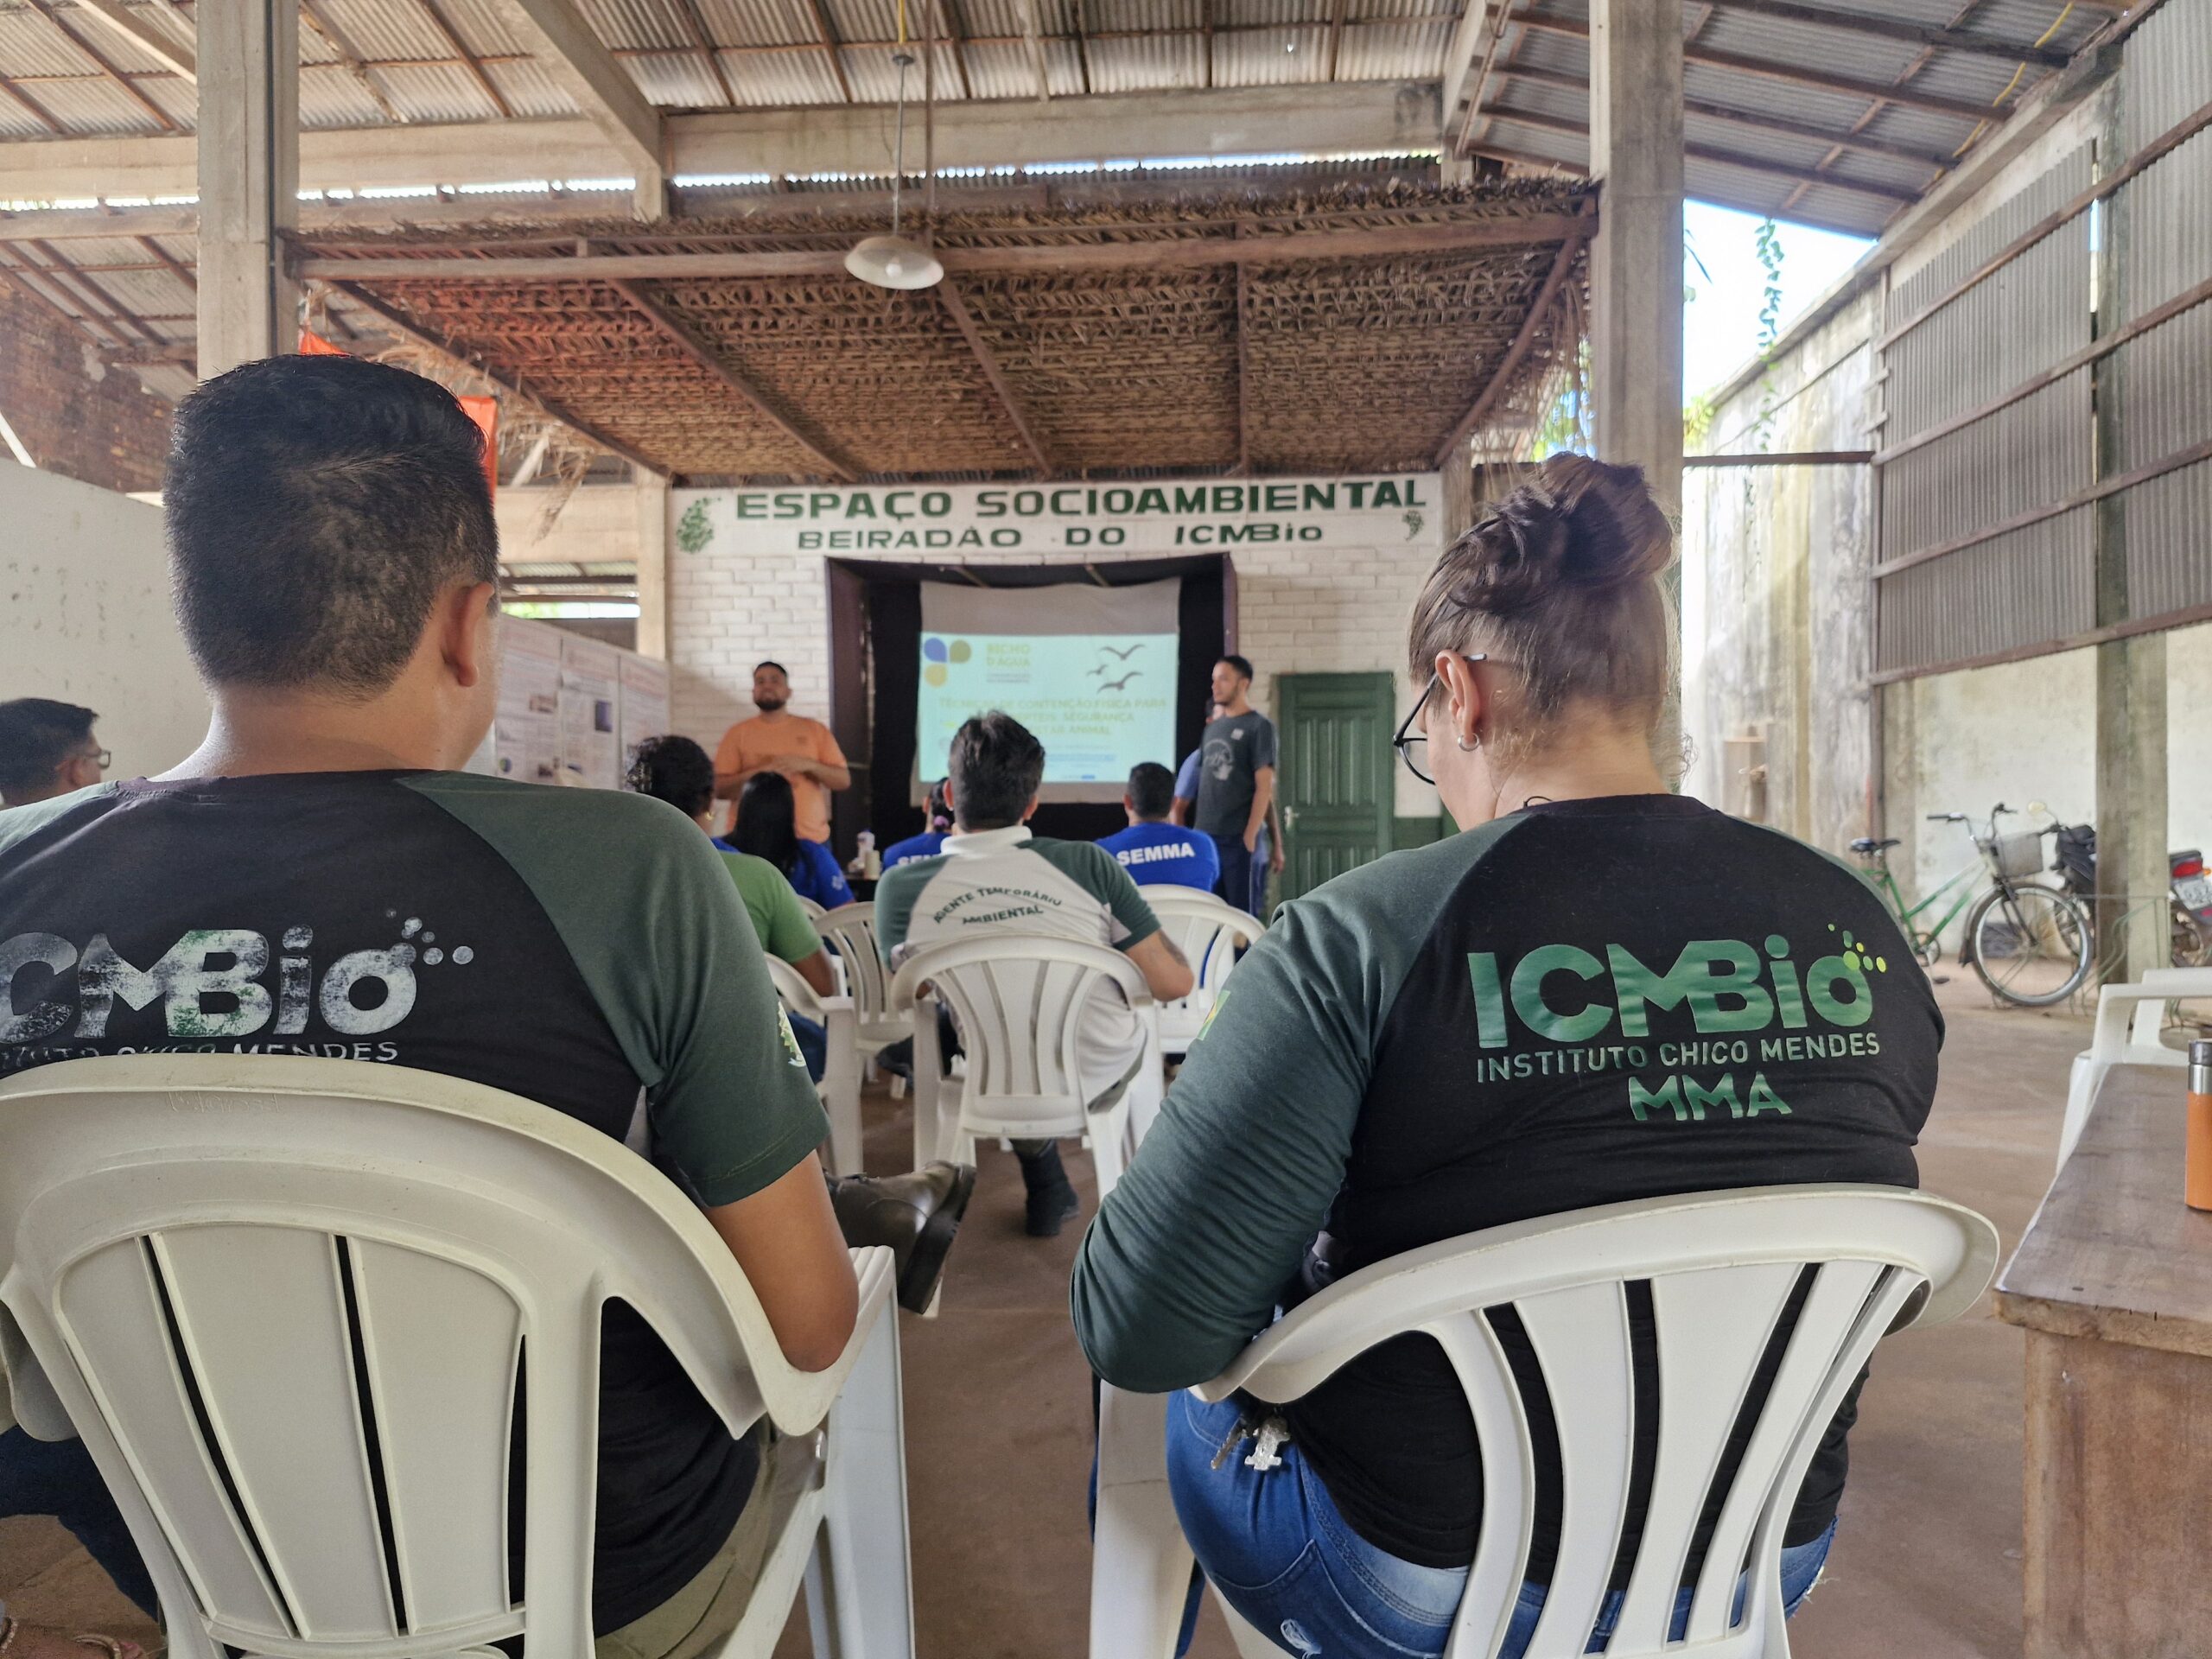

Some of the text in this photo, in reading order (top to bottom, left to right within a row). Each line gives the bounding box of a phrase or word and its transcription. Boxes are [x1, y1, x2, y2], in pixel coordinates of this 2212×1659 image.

[736, 480, 1427, 522] ESPAÇO SOCIOAMBIENTAL
[1065, 527, 1125, 546] DO
[1174, 522, 1323, 544] ICMBio
[1116, 842, 1196, 866] SEMMA
[934, 892, 975, 924] AGENTE
[963, 905, 1044, 925] AMBIENTAL
[1467, 934, 1874, 1048] ICMBio
[1477, 1033, 1880, 1083] INSTITUTO CHICO MENDES
[1628, 1071, 1793, 1122] MMA
